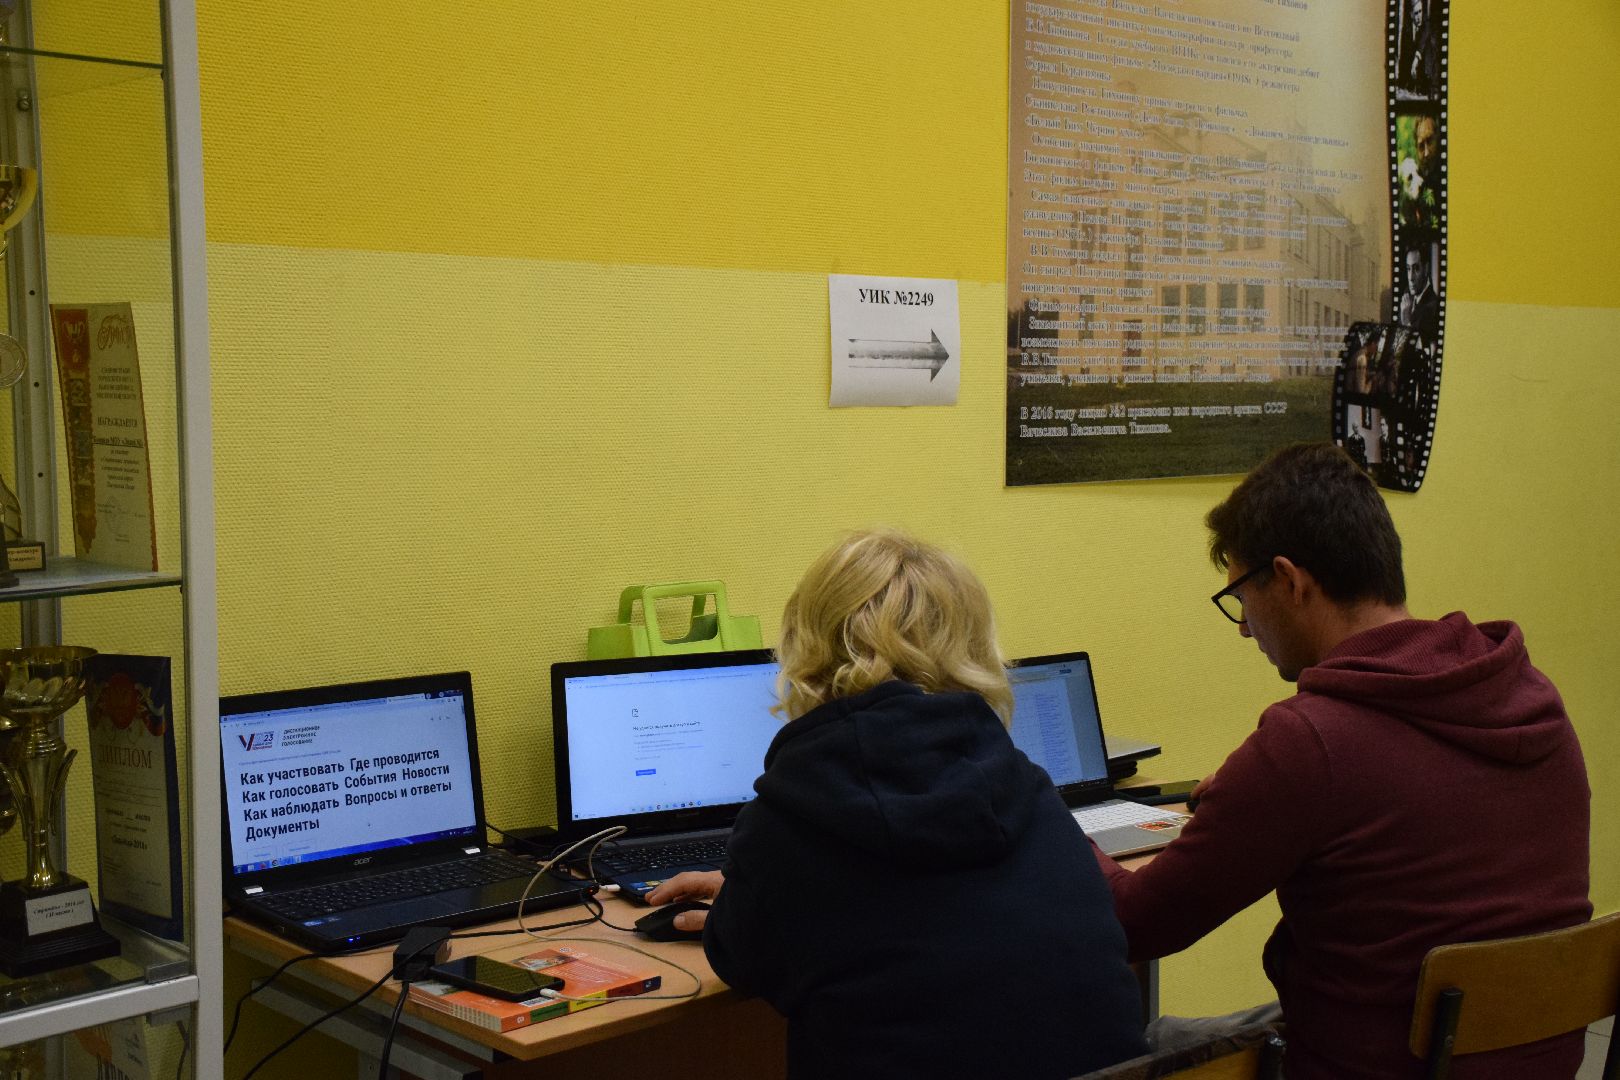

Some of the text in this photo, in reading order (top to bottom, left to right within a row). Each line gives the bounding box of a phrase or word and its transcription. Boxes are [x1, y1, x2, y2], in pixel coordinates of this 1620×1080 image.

[858, 287, 934, 306] УИК №2249
[1020, 406, 1029, 420] В
[1055, 409, 1077, 422] году
[1020, 424, 1069, 438] Вячеслава
[240, 771, 264, 786] Как
[267, 761, 345, 785] участвовать
[350, 757, 370, 773] Где
[373, 748, 440, 771] проводится
[242, 764, 450, 804] Как голосовать События Новости
[243, 780, 453, 822] Как наблюдать Вопросы и ответы
[245, 818, 320, 843] Документы
[353, 855, 373, 866] acer
